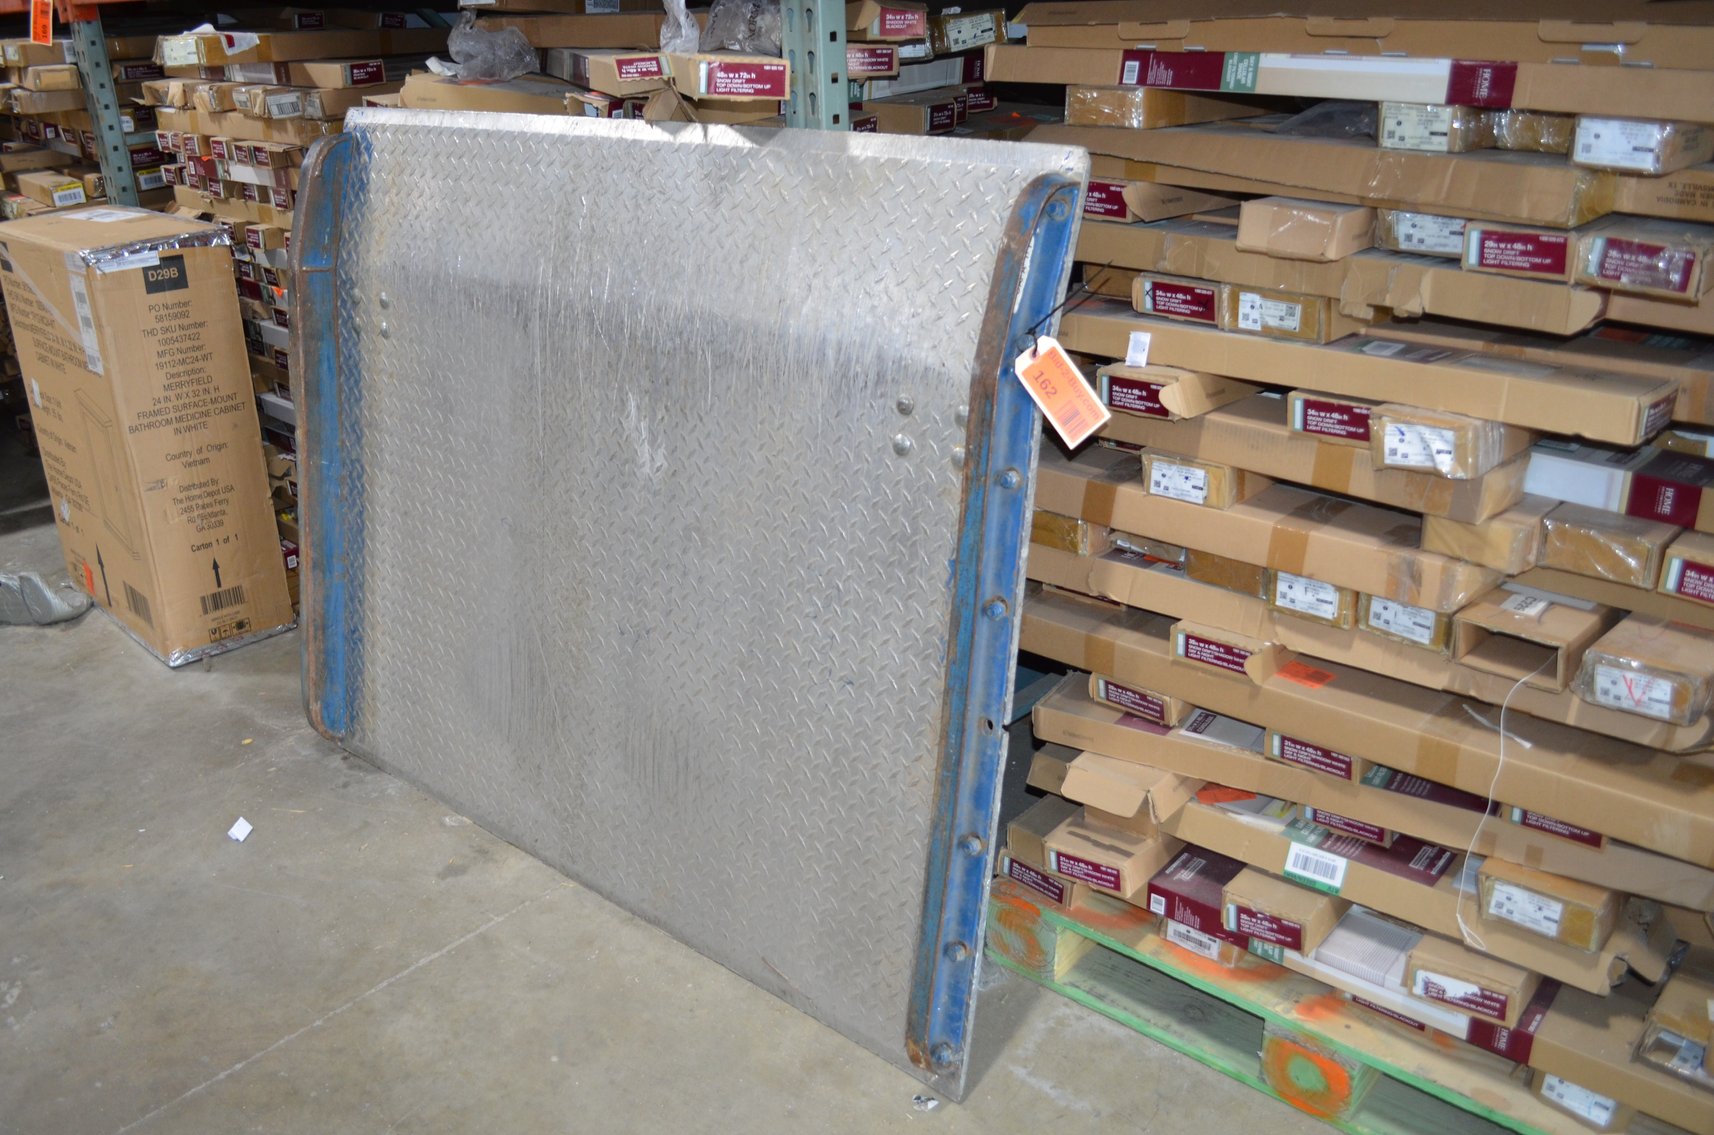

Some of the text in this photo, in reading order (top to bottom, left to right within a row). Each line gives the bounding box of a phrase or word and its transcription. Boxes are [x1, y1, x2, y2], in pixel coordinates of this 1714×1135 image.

[1480, 69, 1491, 98] HOME
[148, 267, 179, 281] D29B
[148, 300, 192, 313] PO Number:
[155, 310, 191, 324] 58159092
[142, 320, 208, 338] THD SKU Number:
[157, 344, 206, 359] MFG Number:
[165, 367, 206, 381] Description:
[163, 375, 213, 392] MERRYFIELD
[1033, 370, 1057, 399] 162
[153, 397, 161, 406] 24
[175, 393, 183, 401] W
[192, 390, 201, 398] 32
[214, 385, 220, 394] H
[137, 392, 238, 420] FRAMED SURFACE-MOUNT
[128, 402, 246, 434] BATHROOM MEDICINE CABINET
[174, 421, 208, 436] IN WHITE
[165, 442, 229, 462] Country of Origin:
[181, 457, 210, 469] Vietnam
[211, 478, 219, 487] By
[173, 484, 235, 505] The Home Depot USA
[1662, 487, 1673, 515] HOME
[191, 533, 238, 553] Carton 1 of 1
